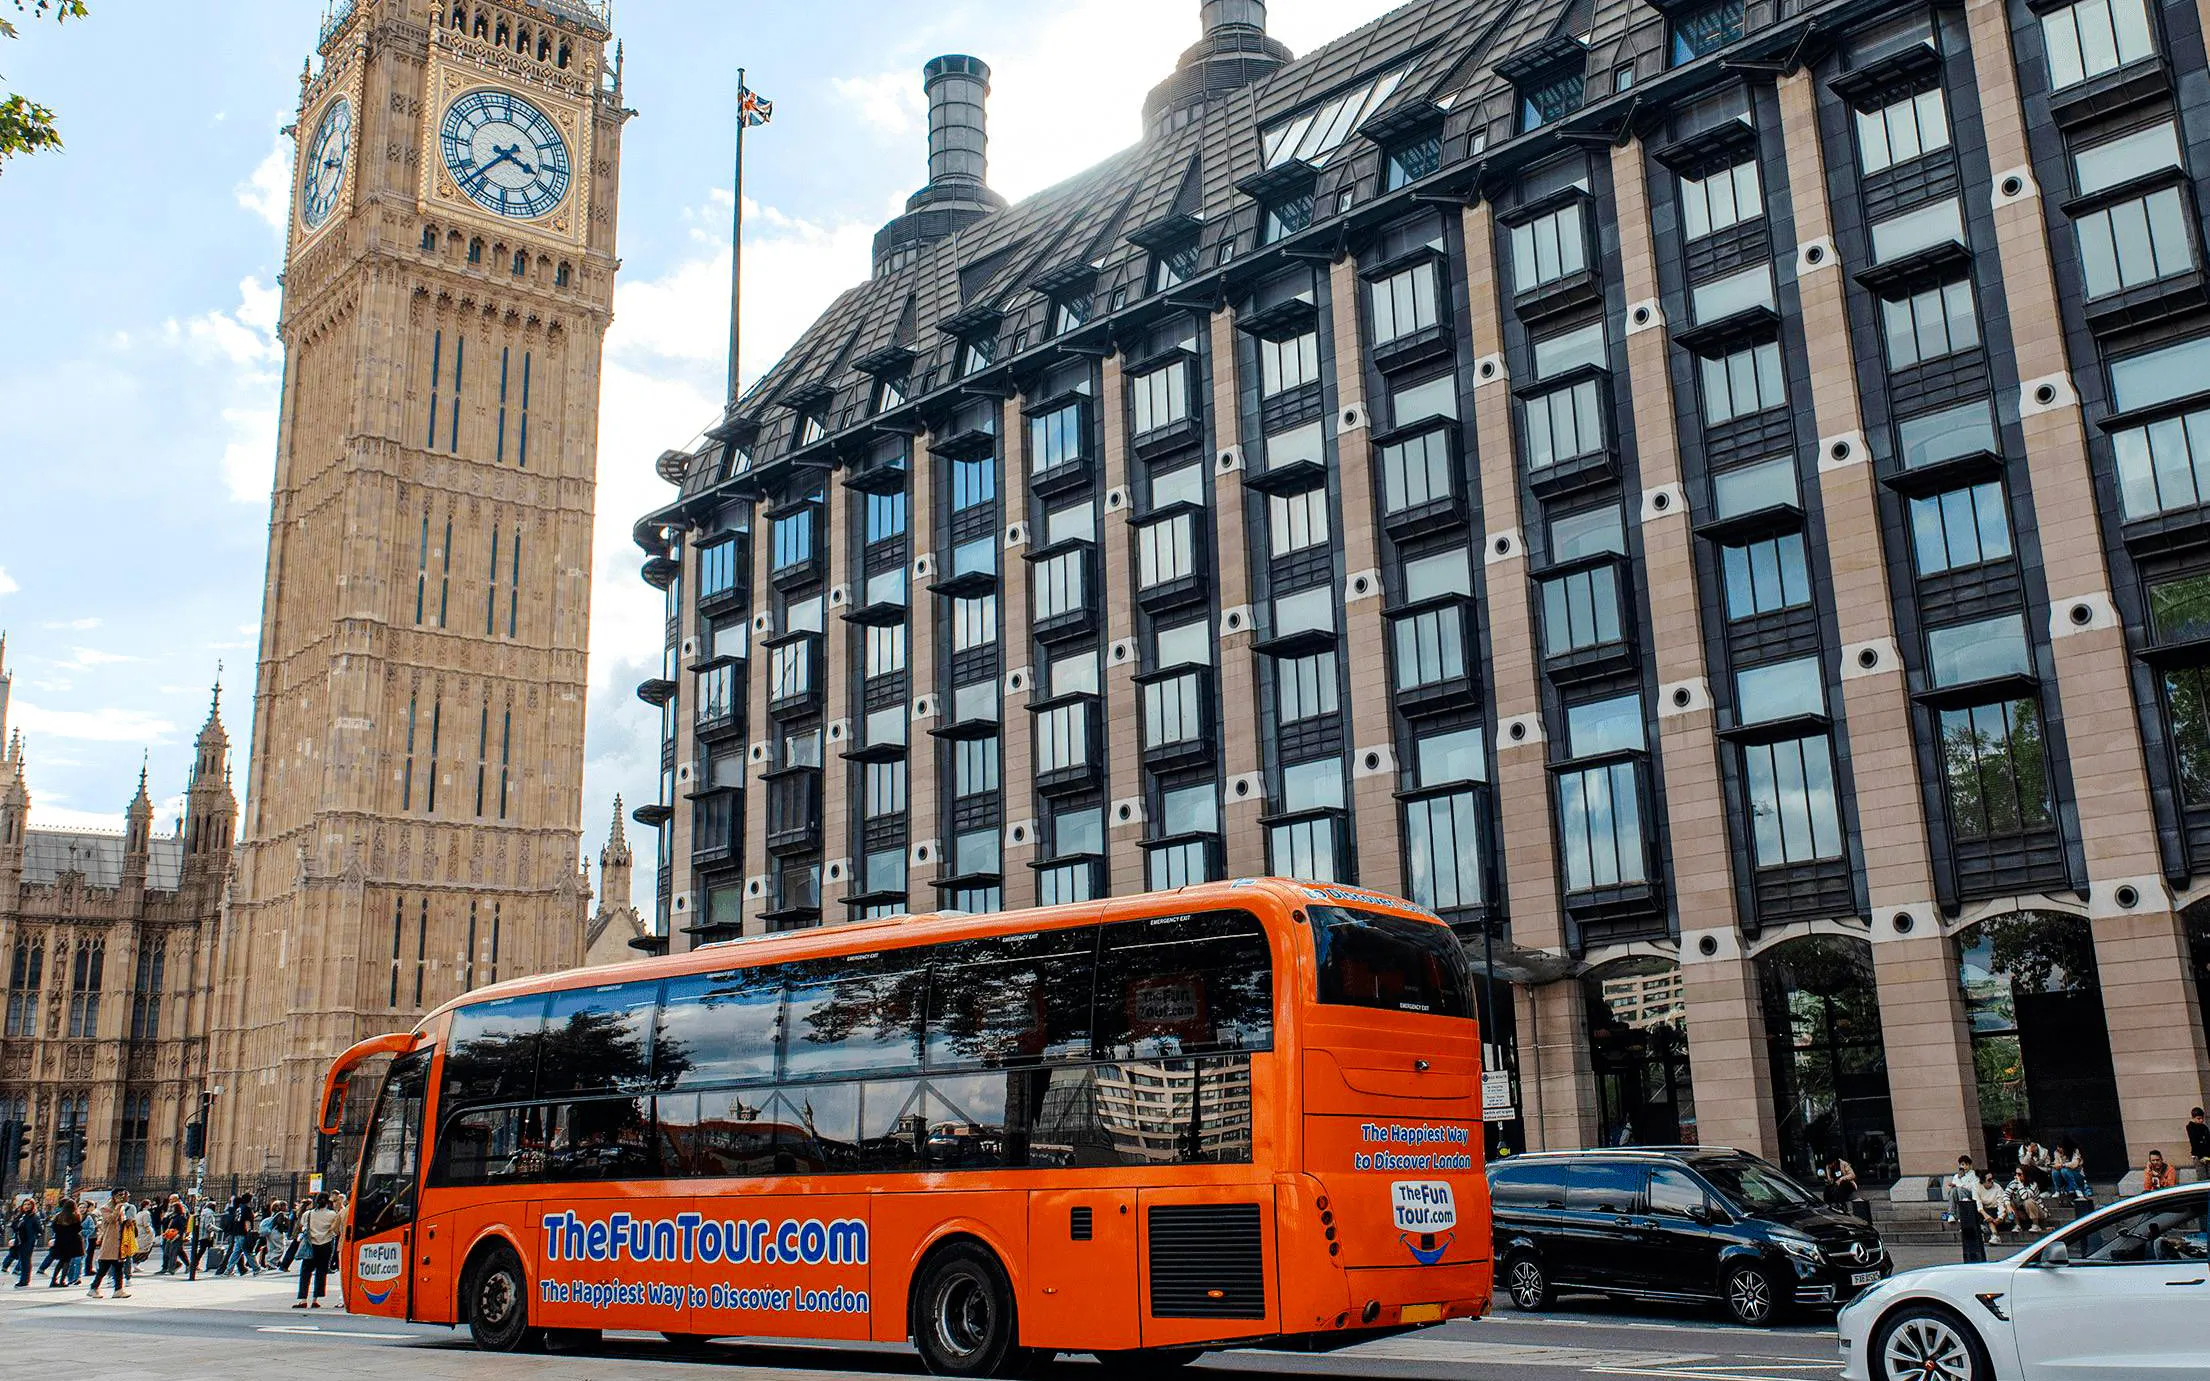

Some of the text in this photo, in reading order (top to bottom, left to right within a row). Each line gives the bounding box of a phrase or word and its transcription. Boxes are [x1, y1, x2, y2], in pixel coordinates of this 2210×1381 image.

[1150, 917, 1179, 926] EMERGENCY
[1361, 1123, 1469, 1146] The Happiest Way
[1355, 1150, 1471, 1170] to Discover London
[1396, 1206, 1453, 1224] Tour.com
[543, 1209, 869, 1265] TheFunTour.com
[360, 1262, 399, 1275] Tour.com
[540, 1277, 869, 1313] The Happiest Way to Discover London
